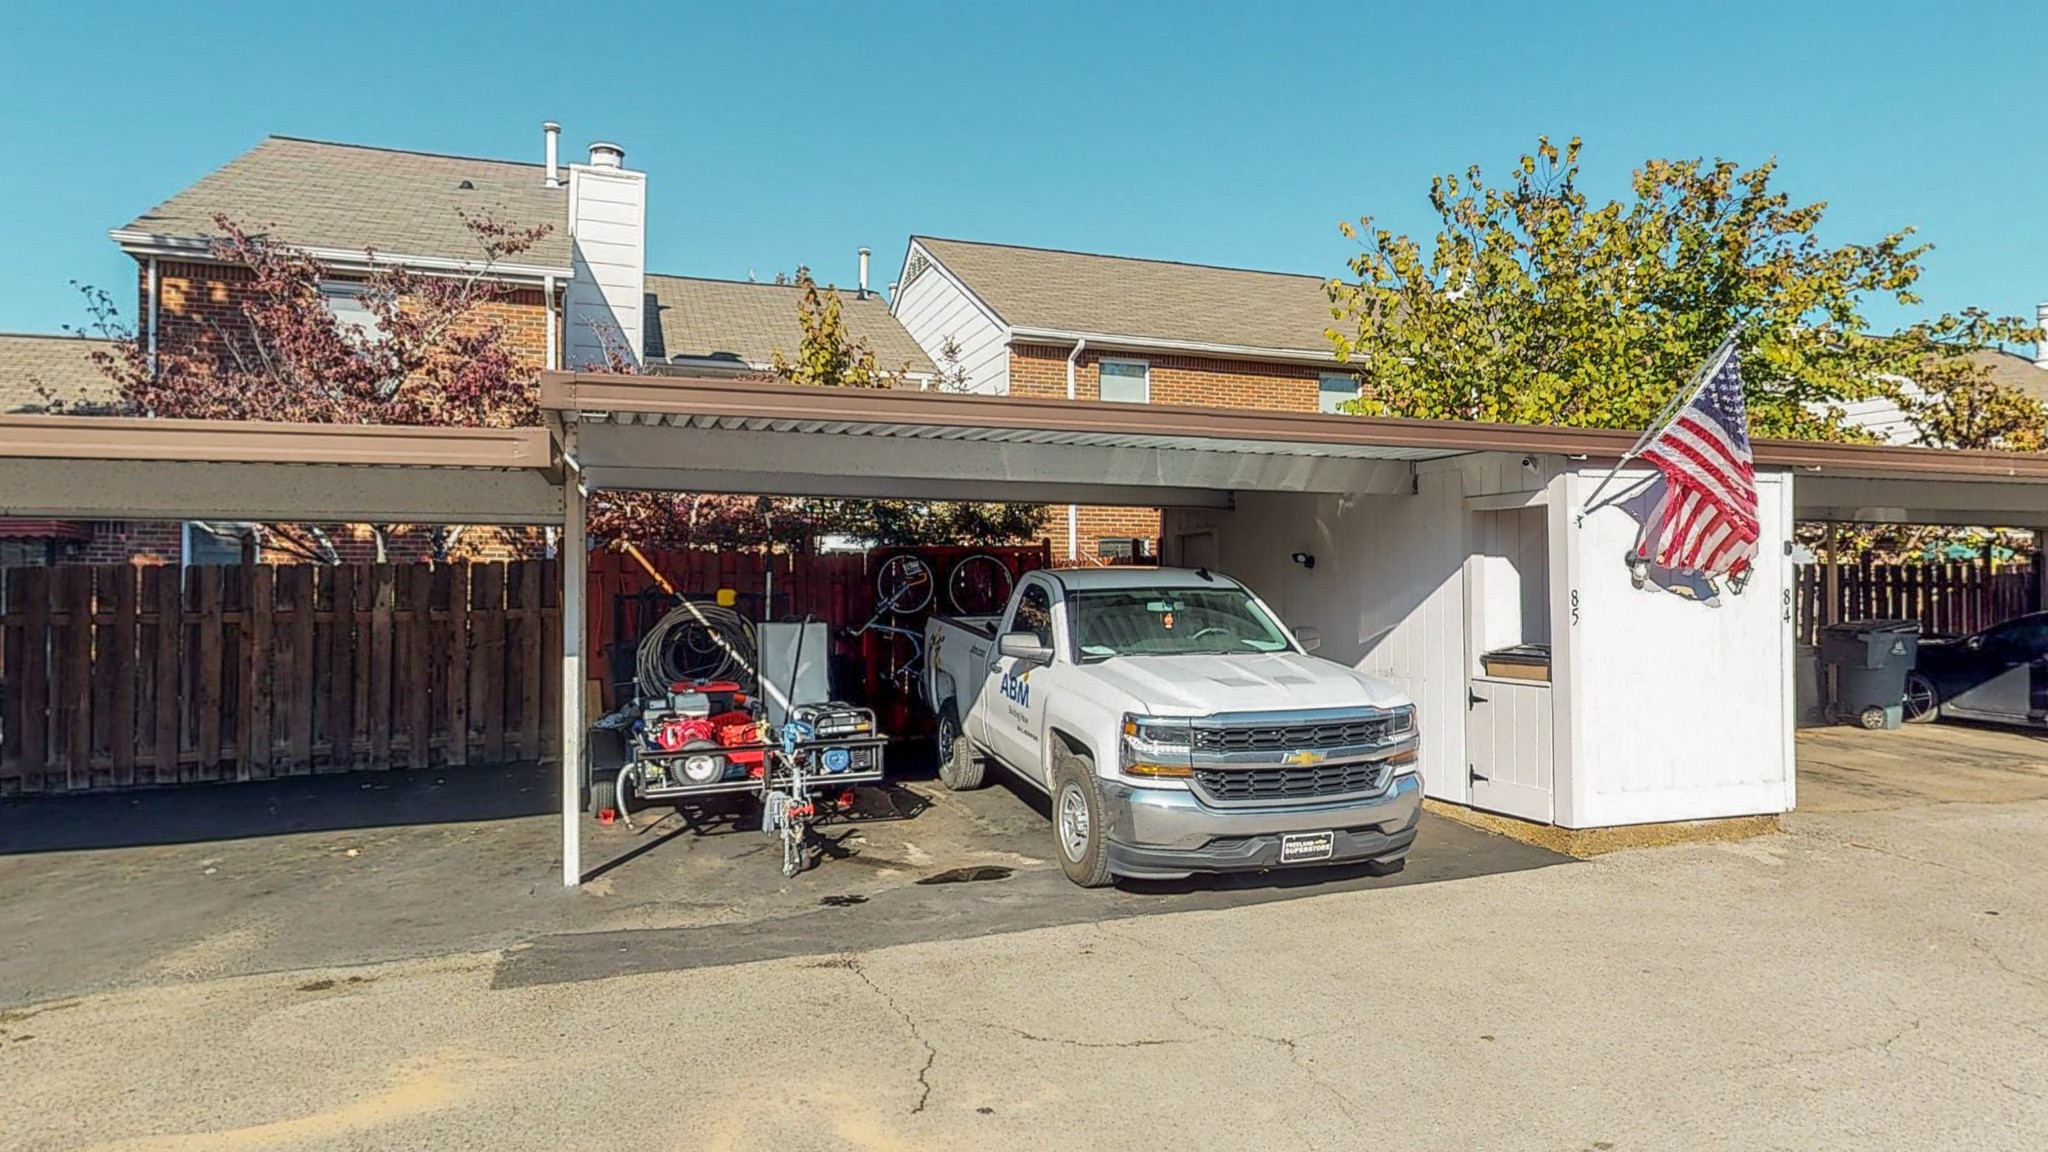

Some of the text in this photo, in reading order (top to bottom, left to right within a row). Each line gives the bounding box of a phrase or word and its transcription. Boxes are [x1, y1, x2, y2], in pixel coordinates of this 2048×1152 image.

[1571, 589, 1579, 626] 85
[1783, 588, 1791, 624] 84
[1000, 673, 1030, 709] ABM
[1285, 844, 1330, 854] SUPERSTORE
